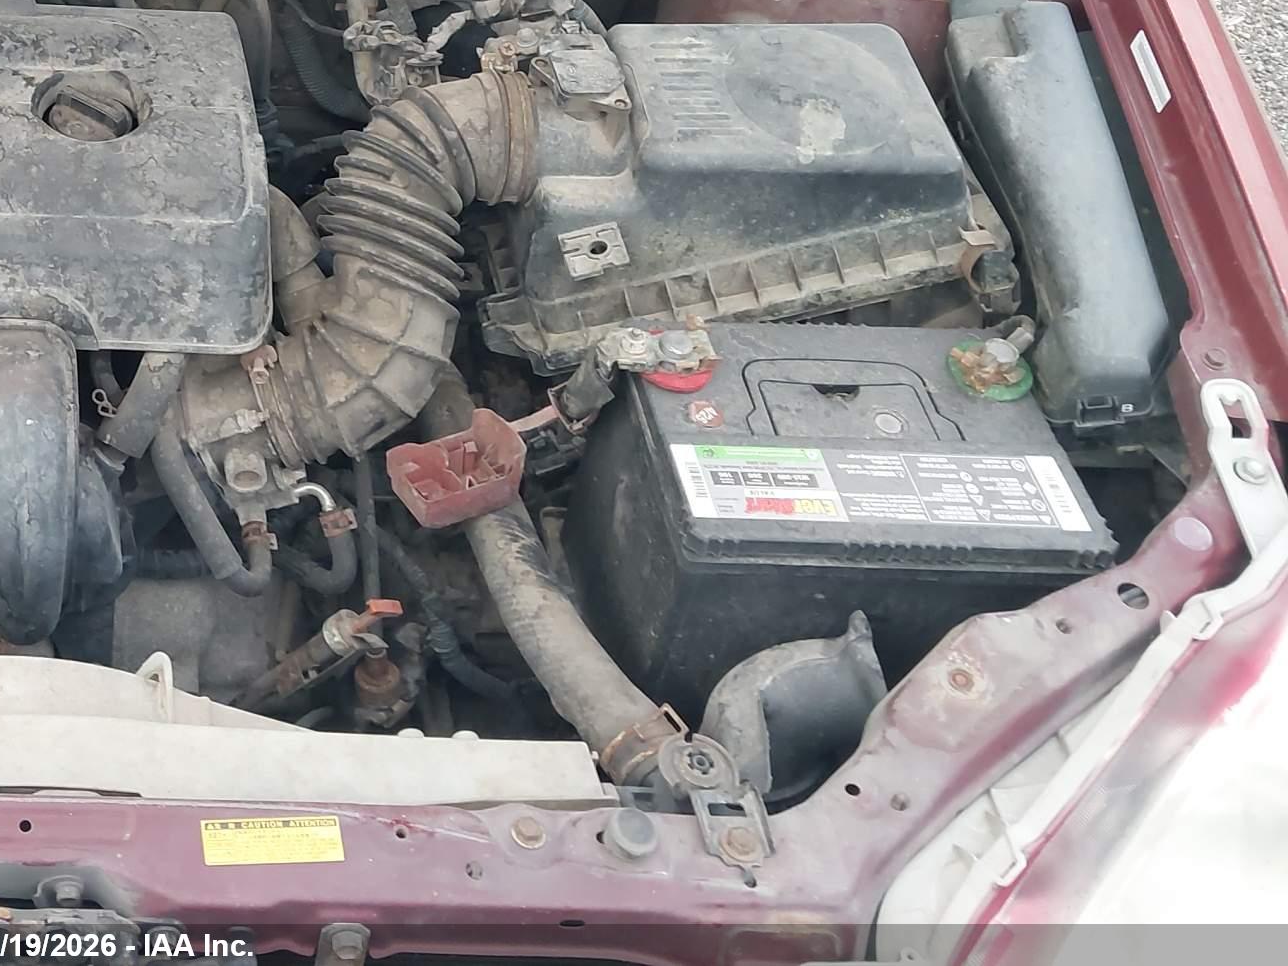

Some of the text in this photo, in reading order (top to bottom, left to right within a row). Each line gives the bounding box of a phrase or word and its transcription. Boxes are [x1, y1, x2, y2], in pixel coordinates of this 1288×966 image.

[1121, 403, 1134, 413] B
[241, 820, 284, 829] CAUTION
[289, 818, 335, 827] ATTENTION
